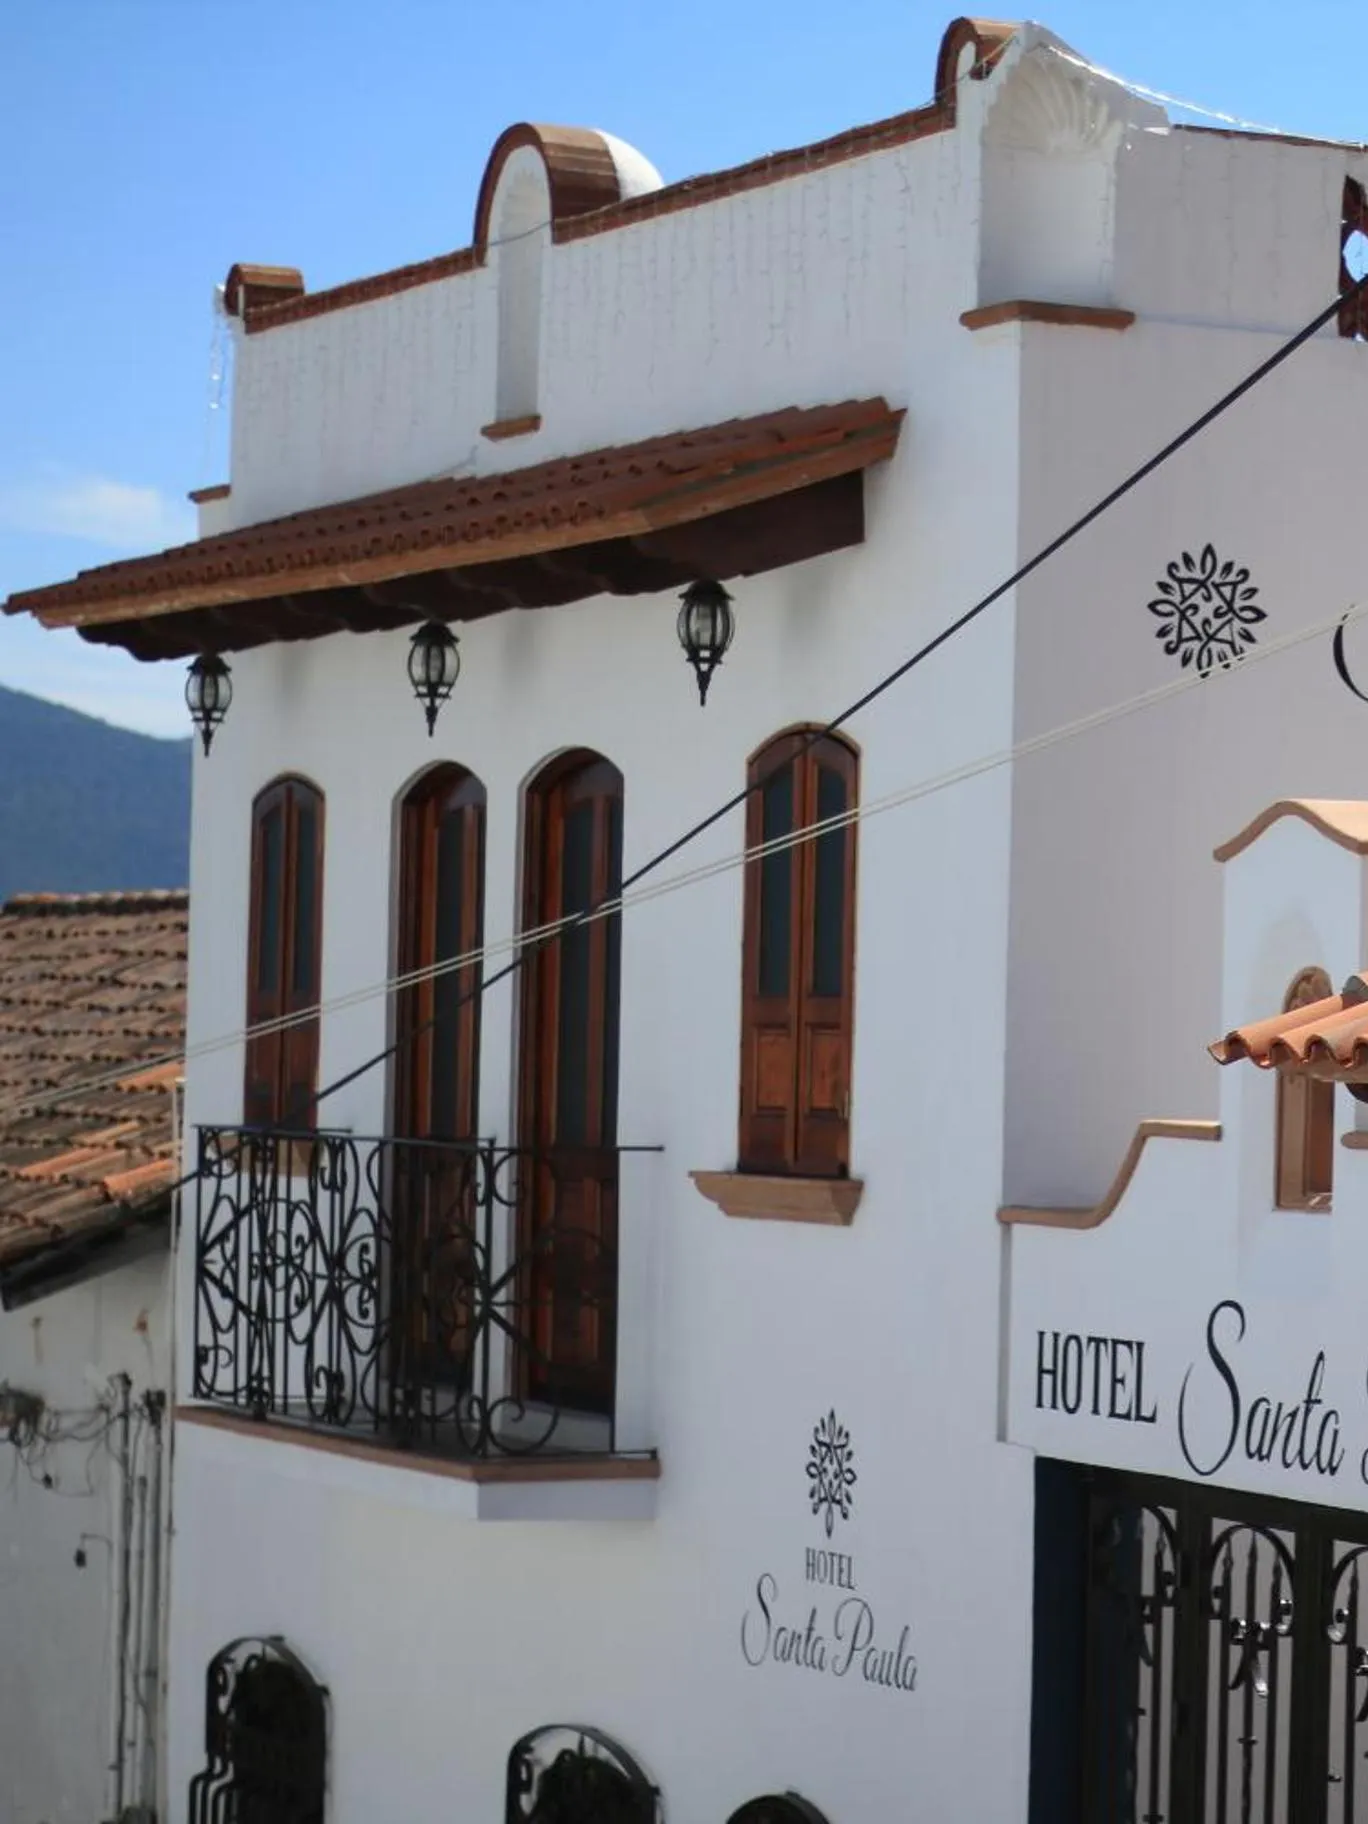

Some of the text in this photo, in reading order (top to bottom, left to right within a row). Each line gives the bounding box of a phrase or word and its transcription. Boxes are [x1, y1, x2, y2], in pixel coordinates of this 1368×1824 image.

[1036, 1331, 1157, 1423] HOTEL
[1178, 1300, 1345, 1476] Santa
[805, 1547, 856, 1591] HOTEL
[740, 1573, 918, 1692] Santa Paula
